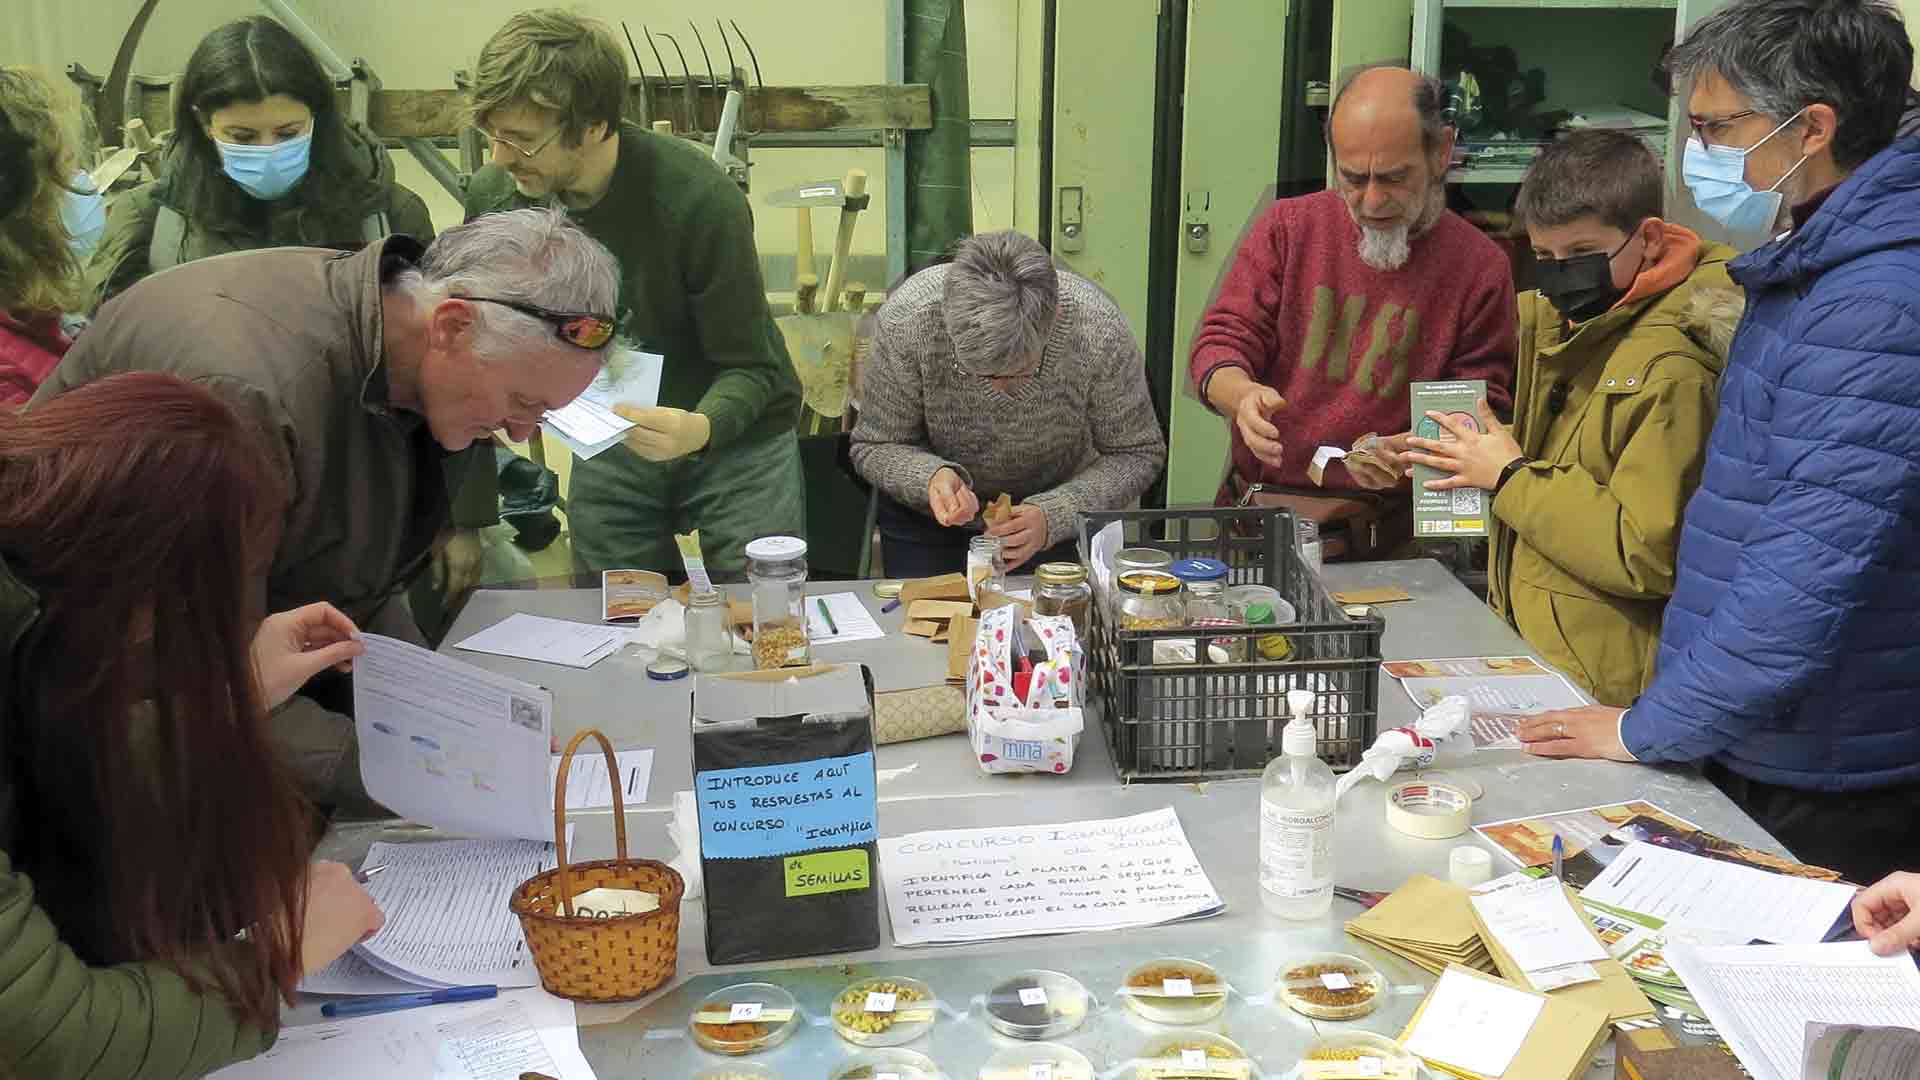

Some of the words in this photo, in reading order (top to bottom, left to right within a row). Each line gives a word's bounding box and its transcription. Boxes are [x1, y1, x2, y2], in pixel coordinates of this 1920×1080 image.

[707, 772, 799, 790] INTRODUCE
[709, 800, 737, 810] TUS
[751, 788, 833, 809] RESPUESTAS
[842, 788, 862, 797] AL
[713, 819, 785, 832] CONCURSO
[898, 834, 1035, 853] CONCURSO
[902, 873, 991, 886] IDENTIFICA
[1031, 864, 1088, 873] PLANTA
[904, 887, 988, 900] PERTENECE
[999, 882, 1035, 890] CADA
